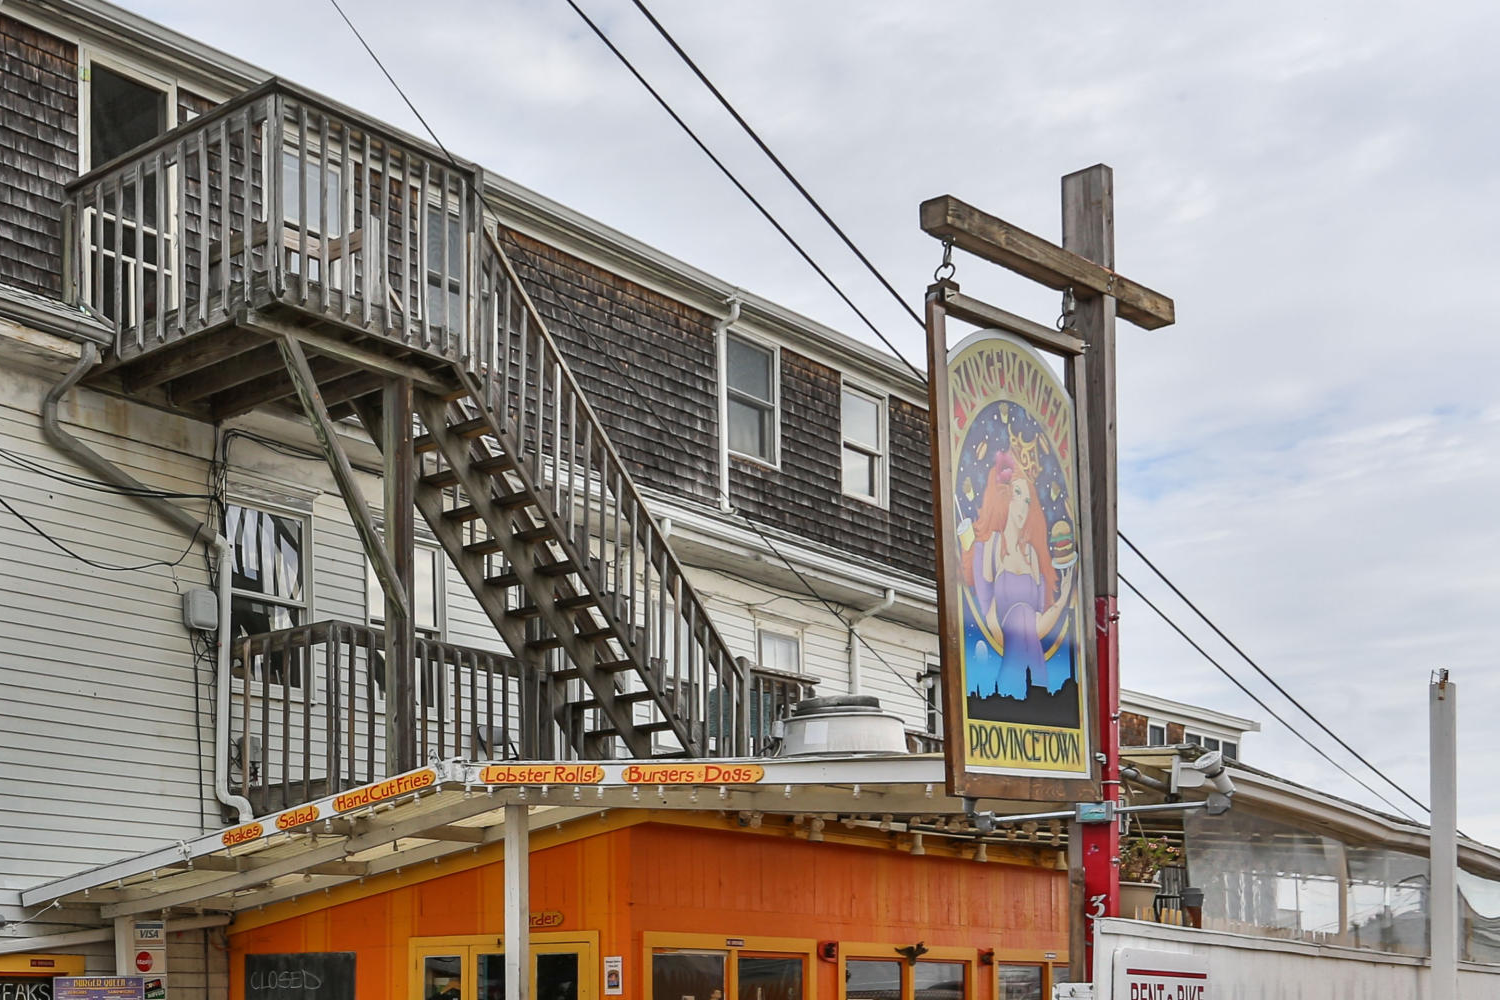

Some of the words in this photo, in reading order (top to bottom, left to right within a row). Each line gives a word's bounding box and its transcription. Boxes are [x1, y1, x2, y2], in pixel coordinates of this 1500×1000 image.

[953, 348, 1018, 412] BURGER
[1016, 358, 1068, 442] QUEEN
[968, 723, 1081, 766] PROVINCETOWN
[484, 766, 551, 783] Lobster
[553, 765, 599, 783] Rolls!
[627, 766, 695, 783] Burgers
[703, 766, 751, 782] Dogs
[336, 792, 369, 811] Hand
[369, 785, 396, 801] Cut
[396, 774, 430, 794] Fries
[278, 809, 314, 829] Salad
[528, 914, 559, 927] rder
[139, 929, 159, 938] VISA
[250, 970, 322, 990] CLOSED
